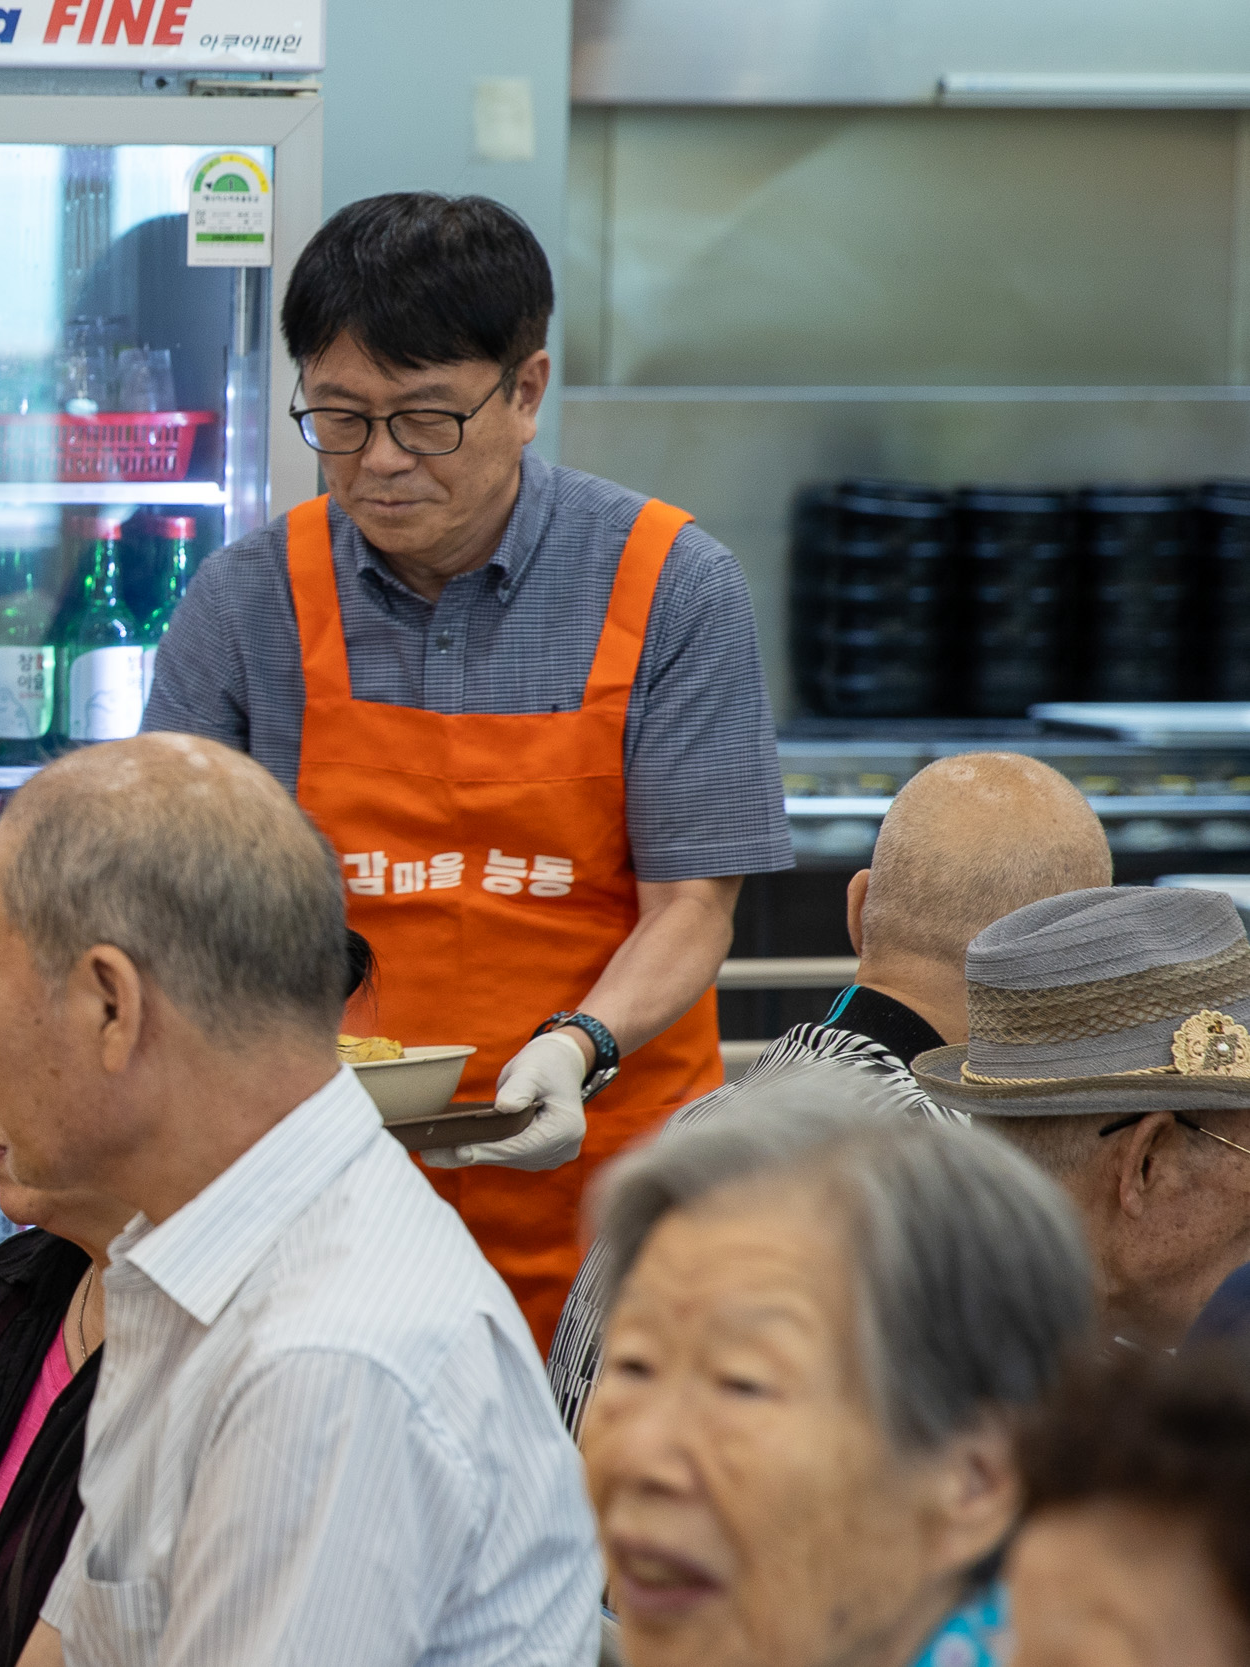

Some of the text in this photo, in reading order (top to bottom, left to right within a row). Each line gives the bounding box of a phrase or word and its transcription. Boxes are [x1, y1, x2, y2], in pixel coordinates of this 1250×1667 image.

[43, 0, 193, 46] FINE
[200, 33, 302, 55] 아쿠아파인
[481, 848, 575, 897] 능동
